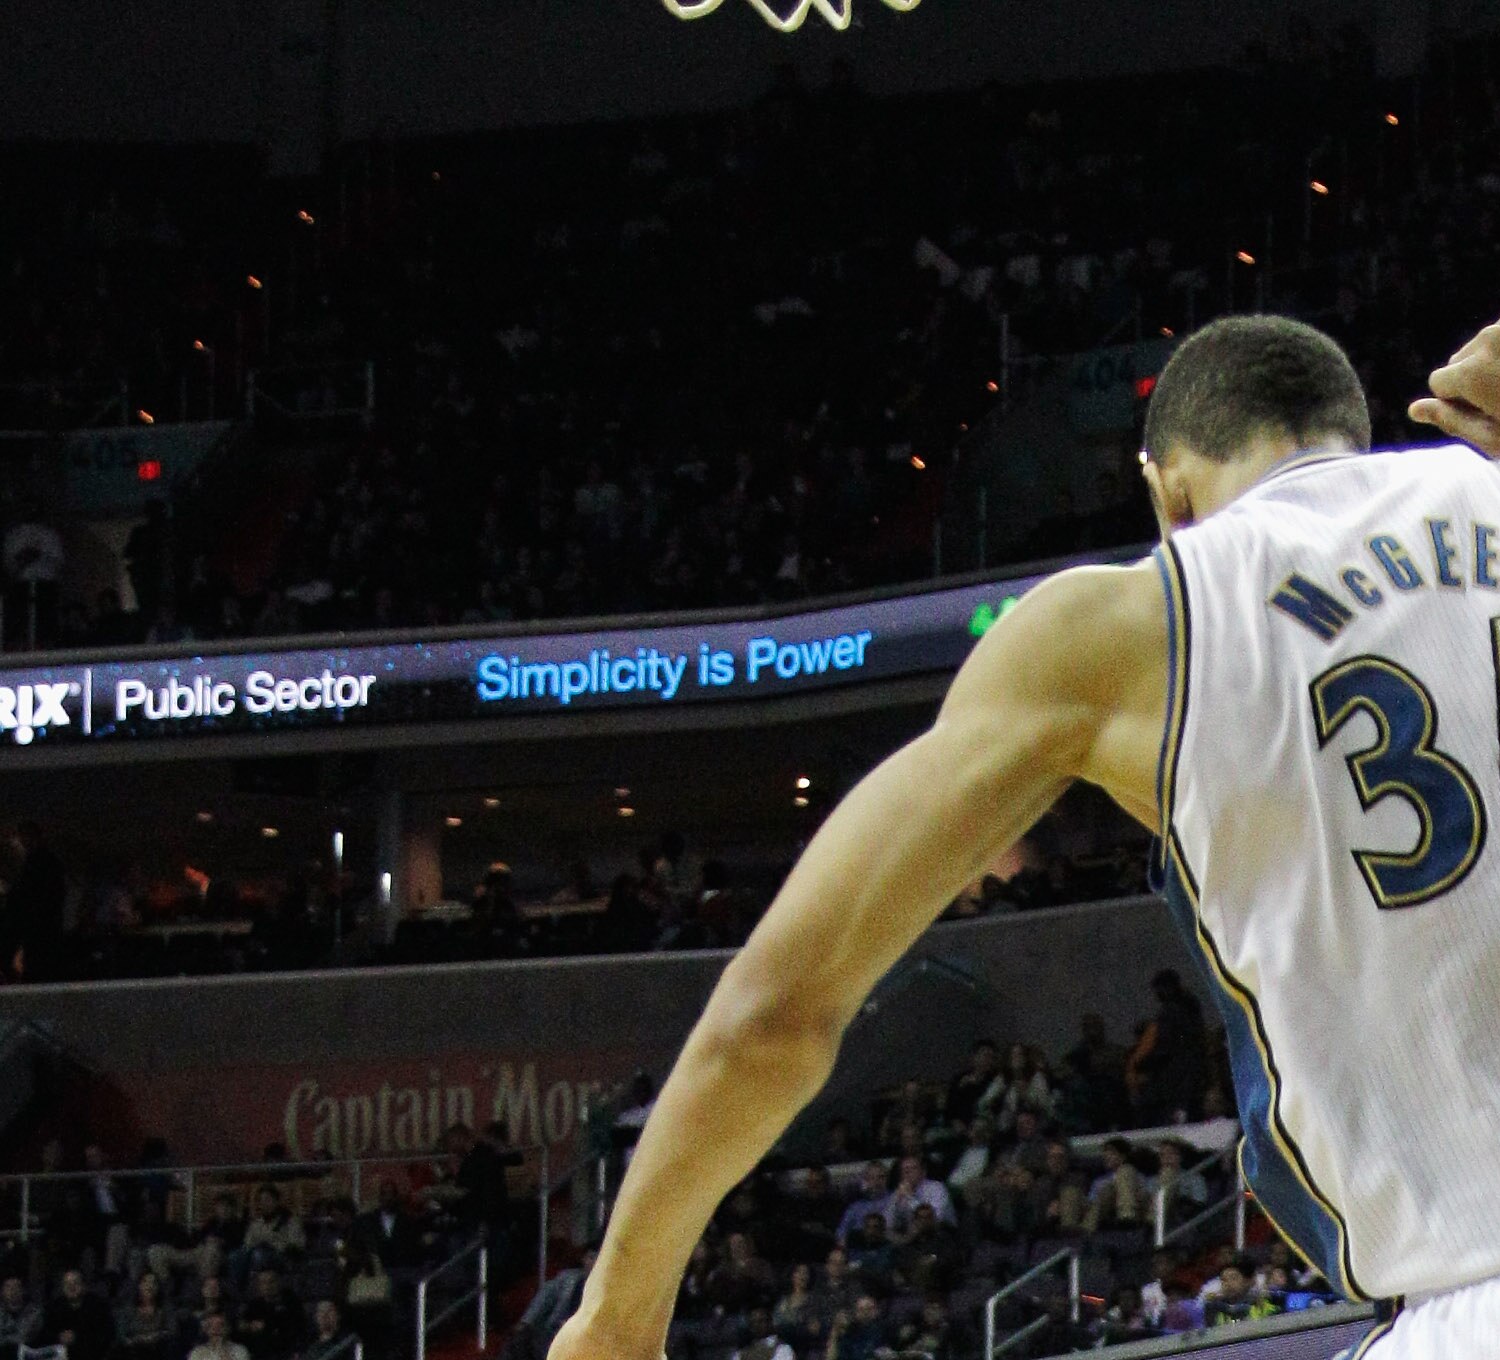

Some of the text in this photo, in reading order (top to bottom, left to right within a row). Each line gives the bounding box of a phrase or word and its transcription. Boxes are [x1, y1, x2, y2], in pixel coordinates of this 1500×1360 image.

[115, 674, 236, 721] Public
[244, 669, 377, 714] Sector
[476, 630, 873, 704] Simplicity is Power
[282, 1066, 476, 1160] Captain
